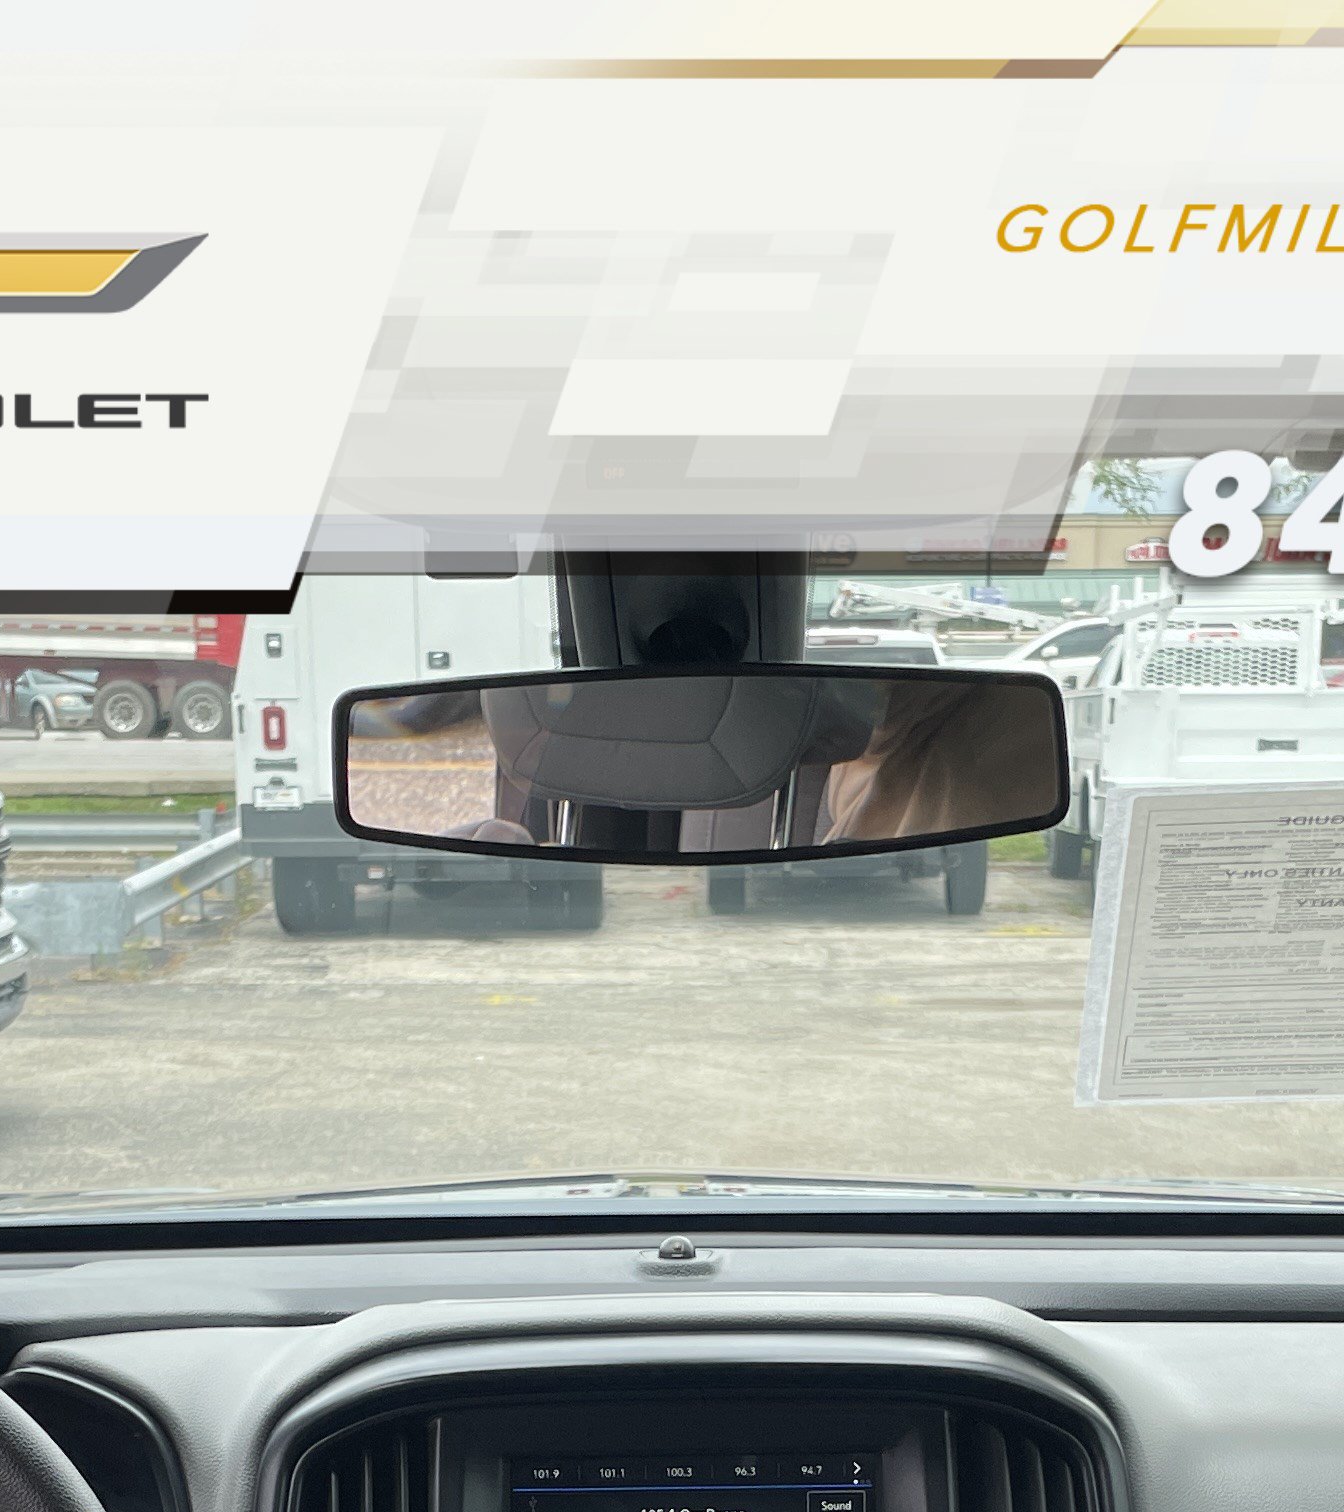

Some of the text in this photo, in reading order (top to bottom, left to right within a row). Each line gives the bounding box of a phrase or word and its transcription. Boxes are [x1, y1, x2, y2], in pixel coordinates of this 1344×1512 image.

[533, 1464, 823, 1480] 101.9 101.1 100.3 96.3 94.7
[820, 1500, 853, 1512] Sound
